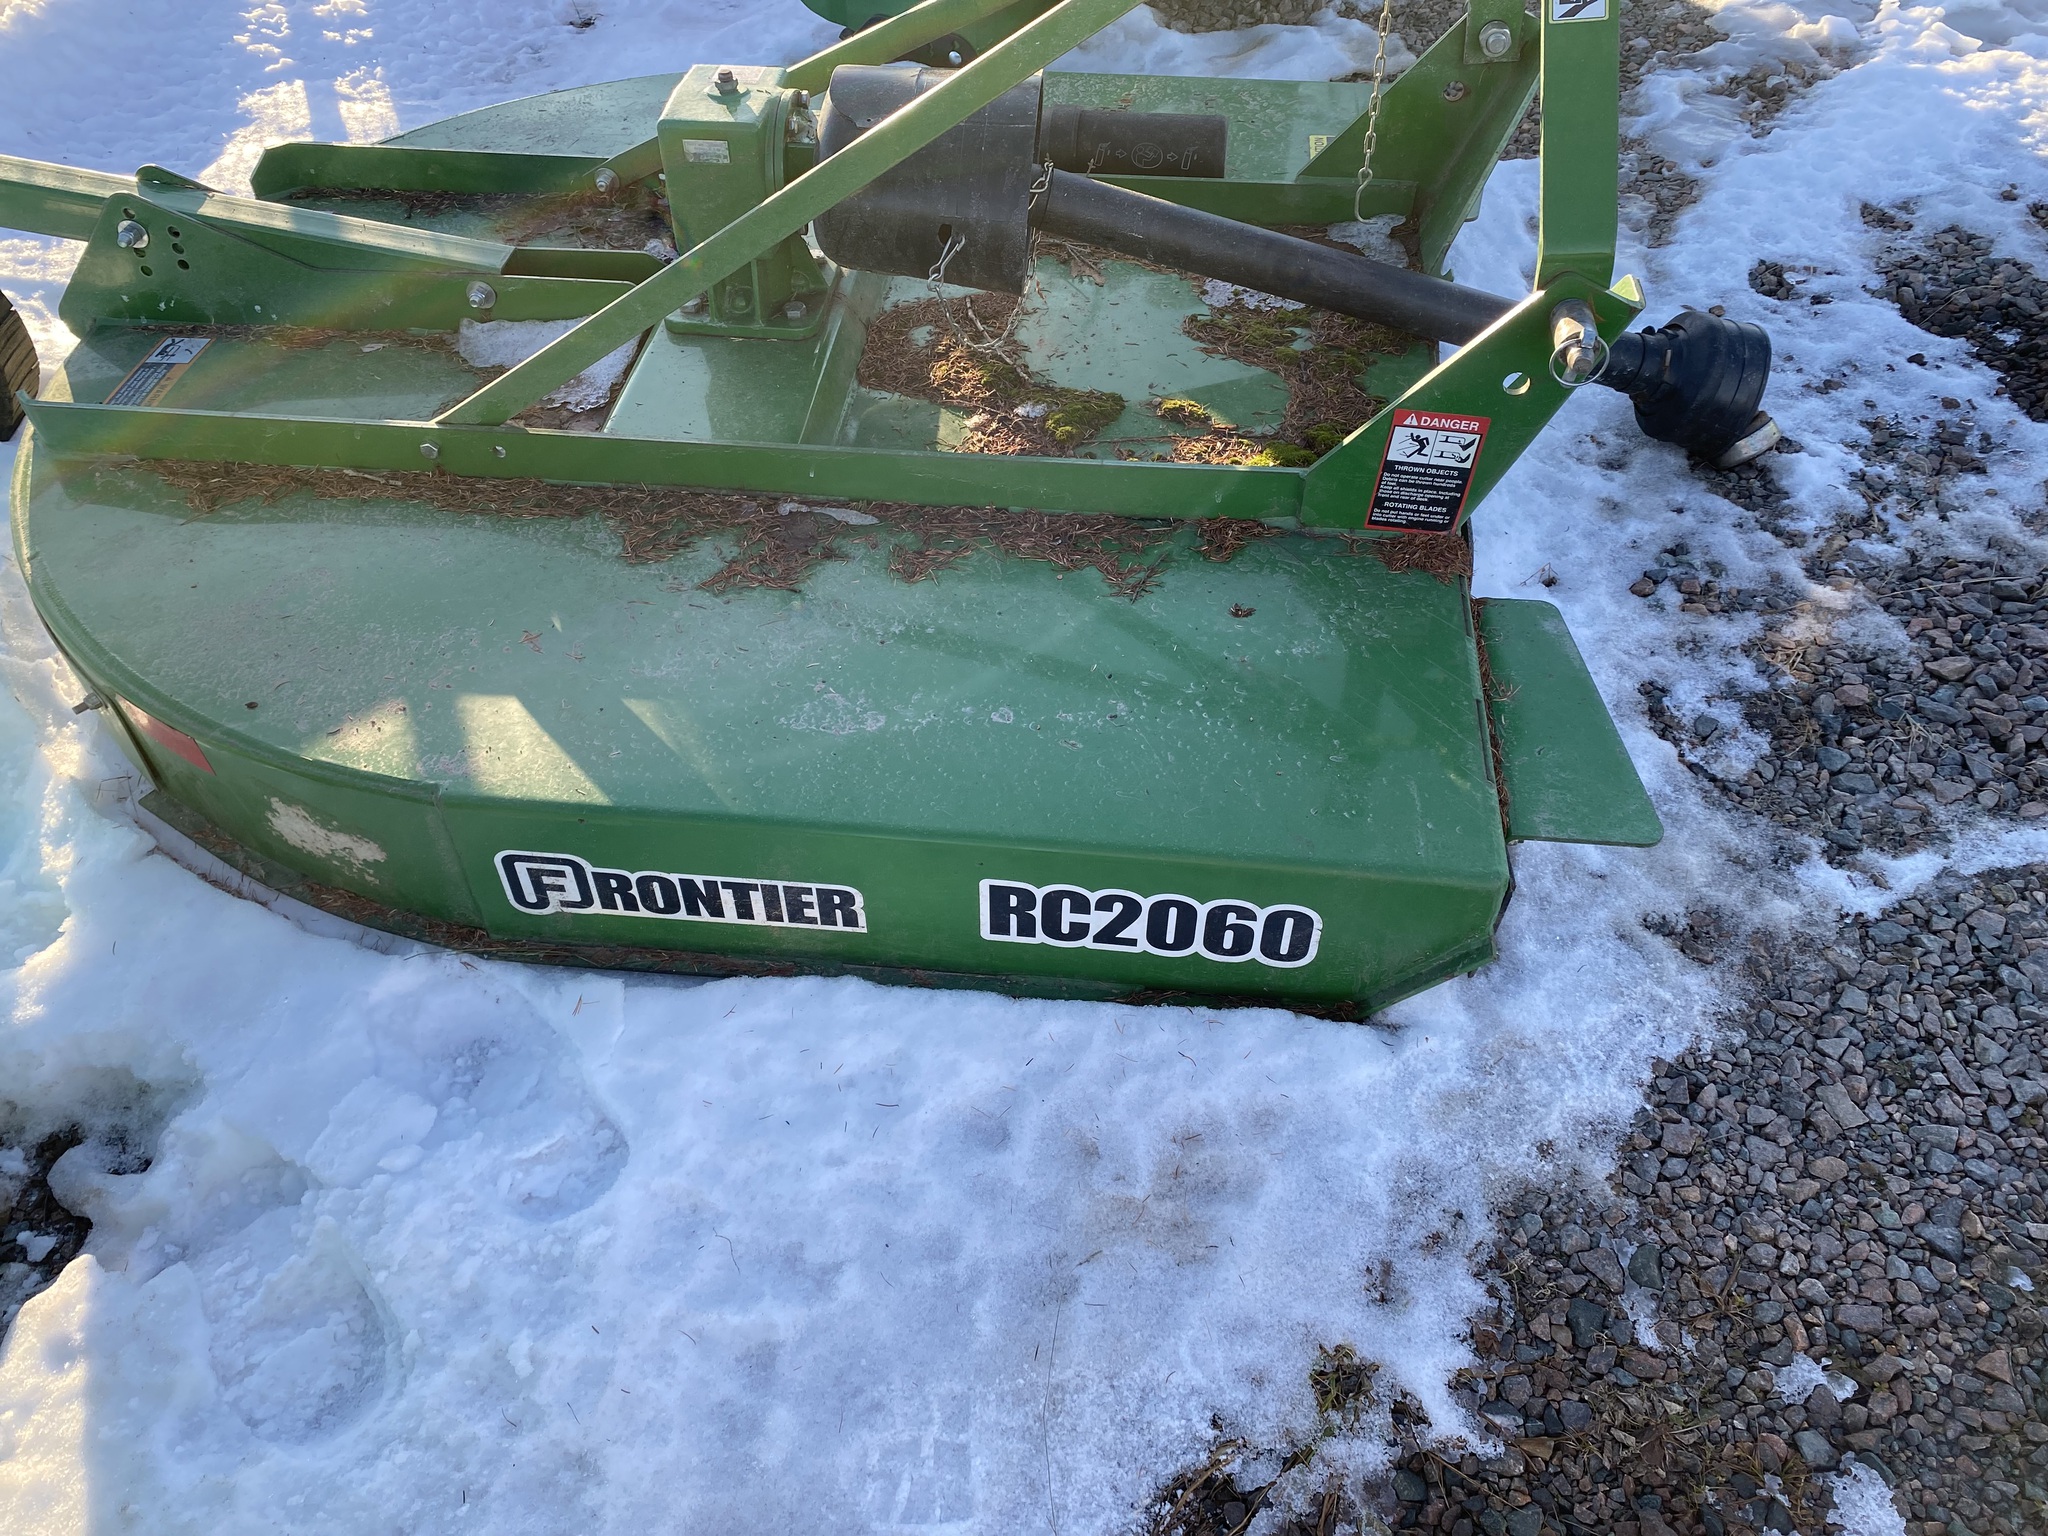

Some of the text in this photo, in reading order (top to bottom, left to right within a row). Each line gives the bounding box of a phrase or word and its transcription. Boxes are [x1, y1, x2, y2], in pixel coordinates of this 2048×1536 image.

[1421, 417, 1479, 431] DANGER
[1395, 465, 1458, 476] THROWN OBJECTS
[499, 854, 1315, 962] FRONTIER RC2060
